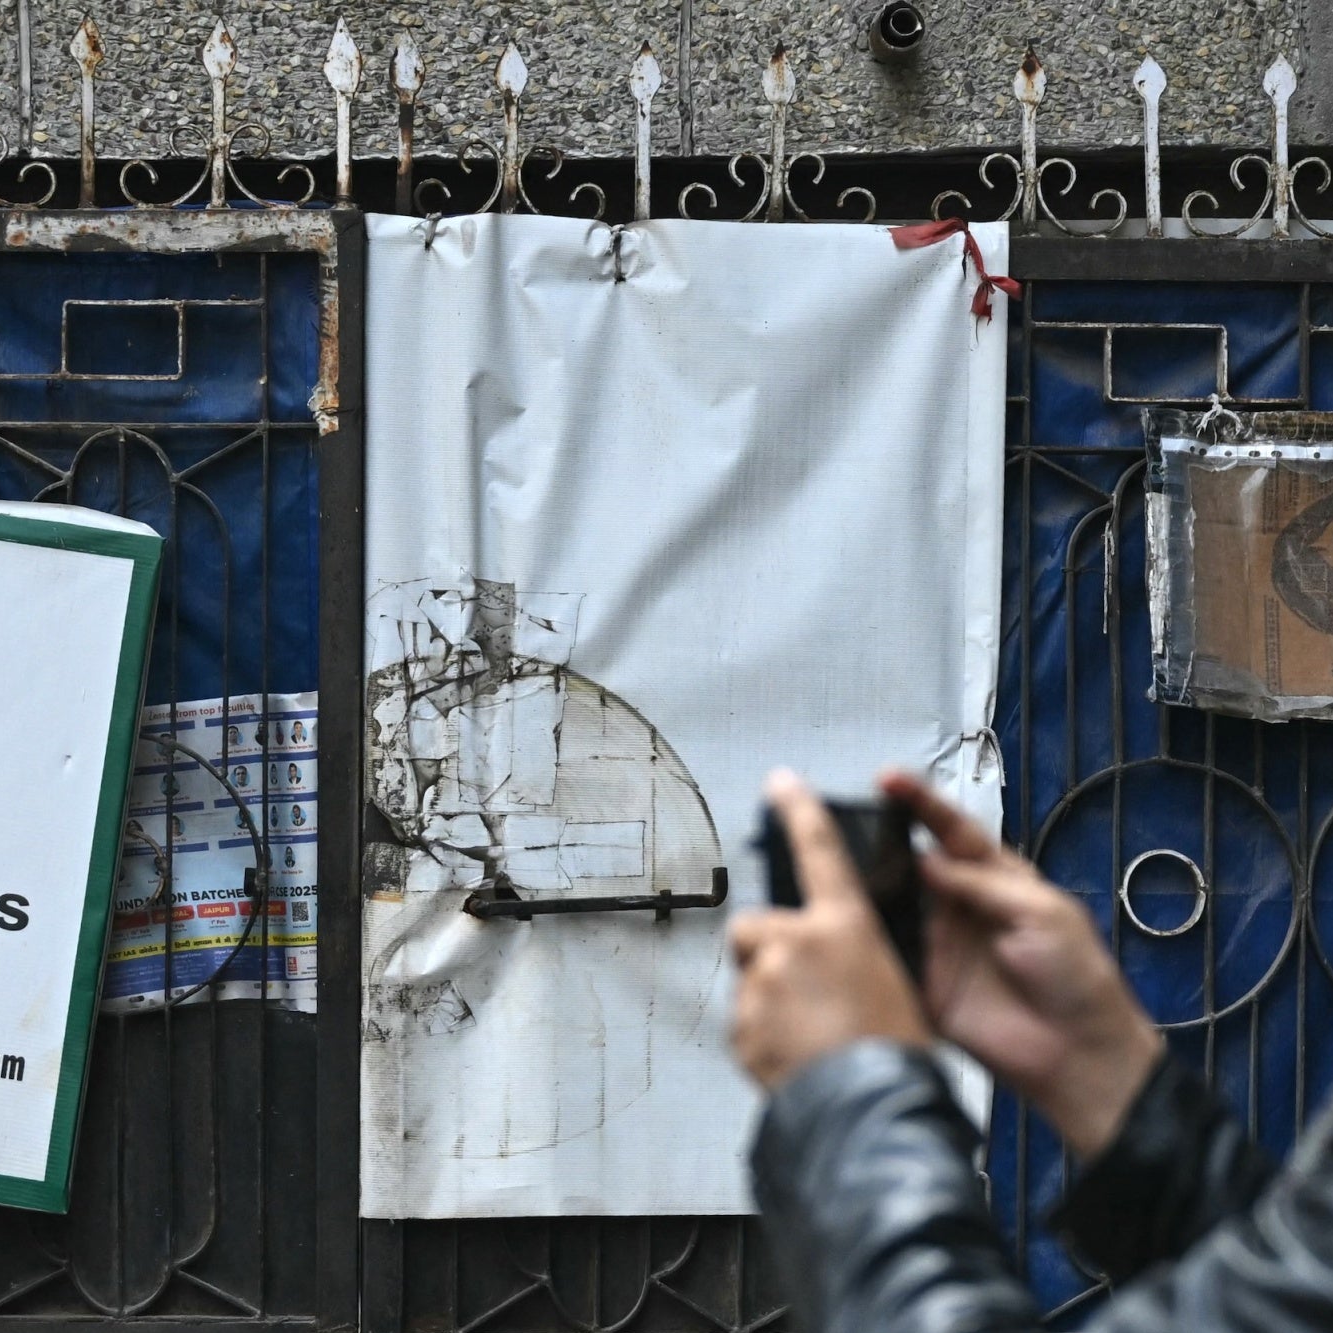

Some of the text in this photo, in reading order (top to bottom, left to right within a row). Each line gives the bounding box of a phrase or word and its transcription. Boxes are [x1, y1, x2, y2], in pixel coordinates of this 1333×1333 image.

[199, 706, 216, 718] top
[217, 702, 256, 715] fculties
[289, 884, 318, 897] 2025
[202, 906, 230, 914] JAIPUR
